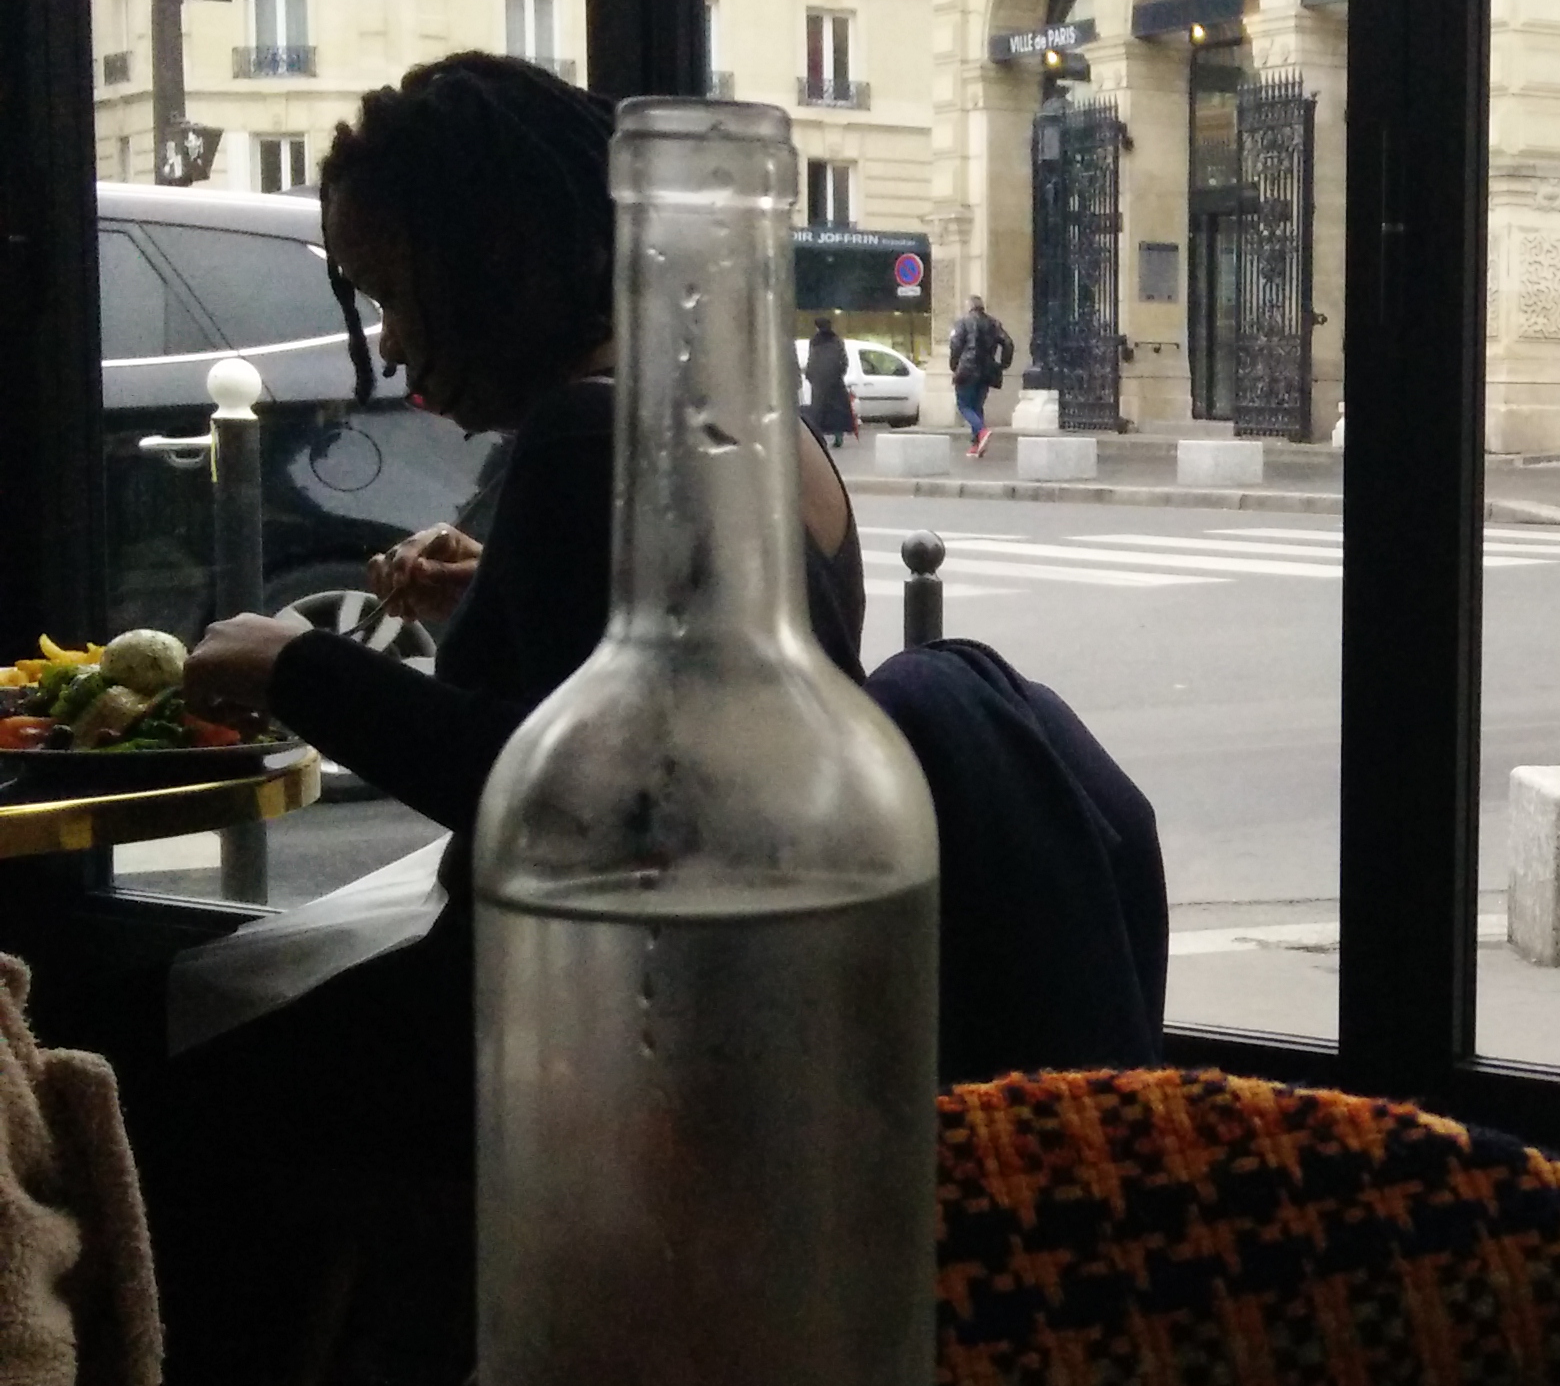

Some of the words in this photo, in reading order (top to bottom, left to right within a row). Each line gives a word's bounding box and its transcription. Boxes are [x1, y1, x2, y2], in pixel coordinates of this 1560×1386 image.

[1009, 33, 1033, 53] VILLE
[1034, 34, 1047, 50] de
[1047, 25, 1076, 47] PARIS
[817, 232, 879, 245] JOFFRIN
